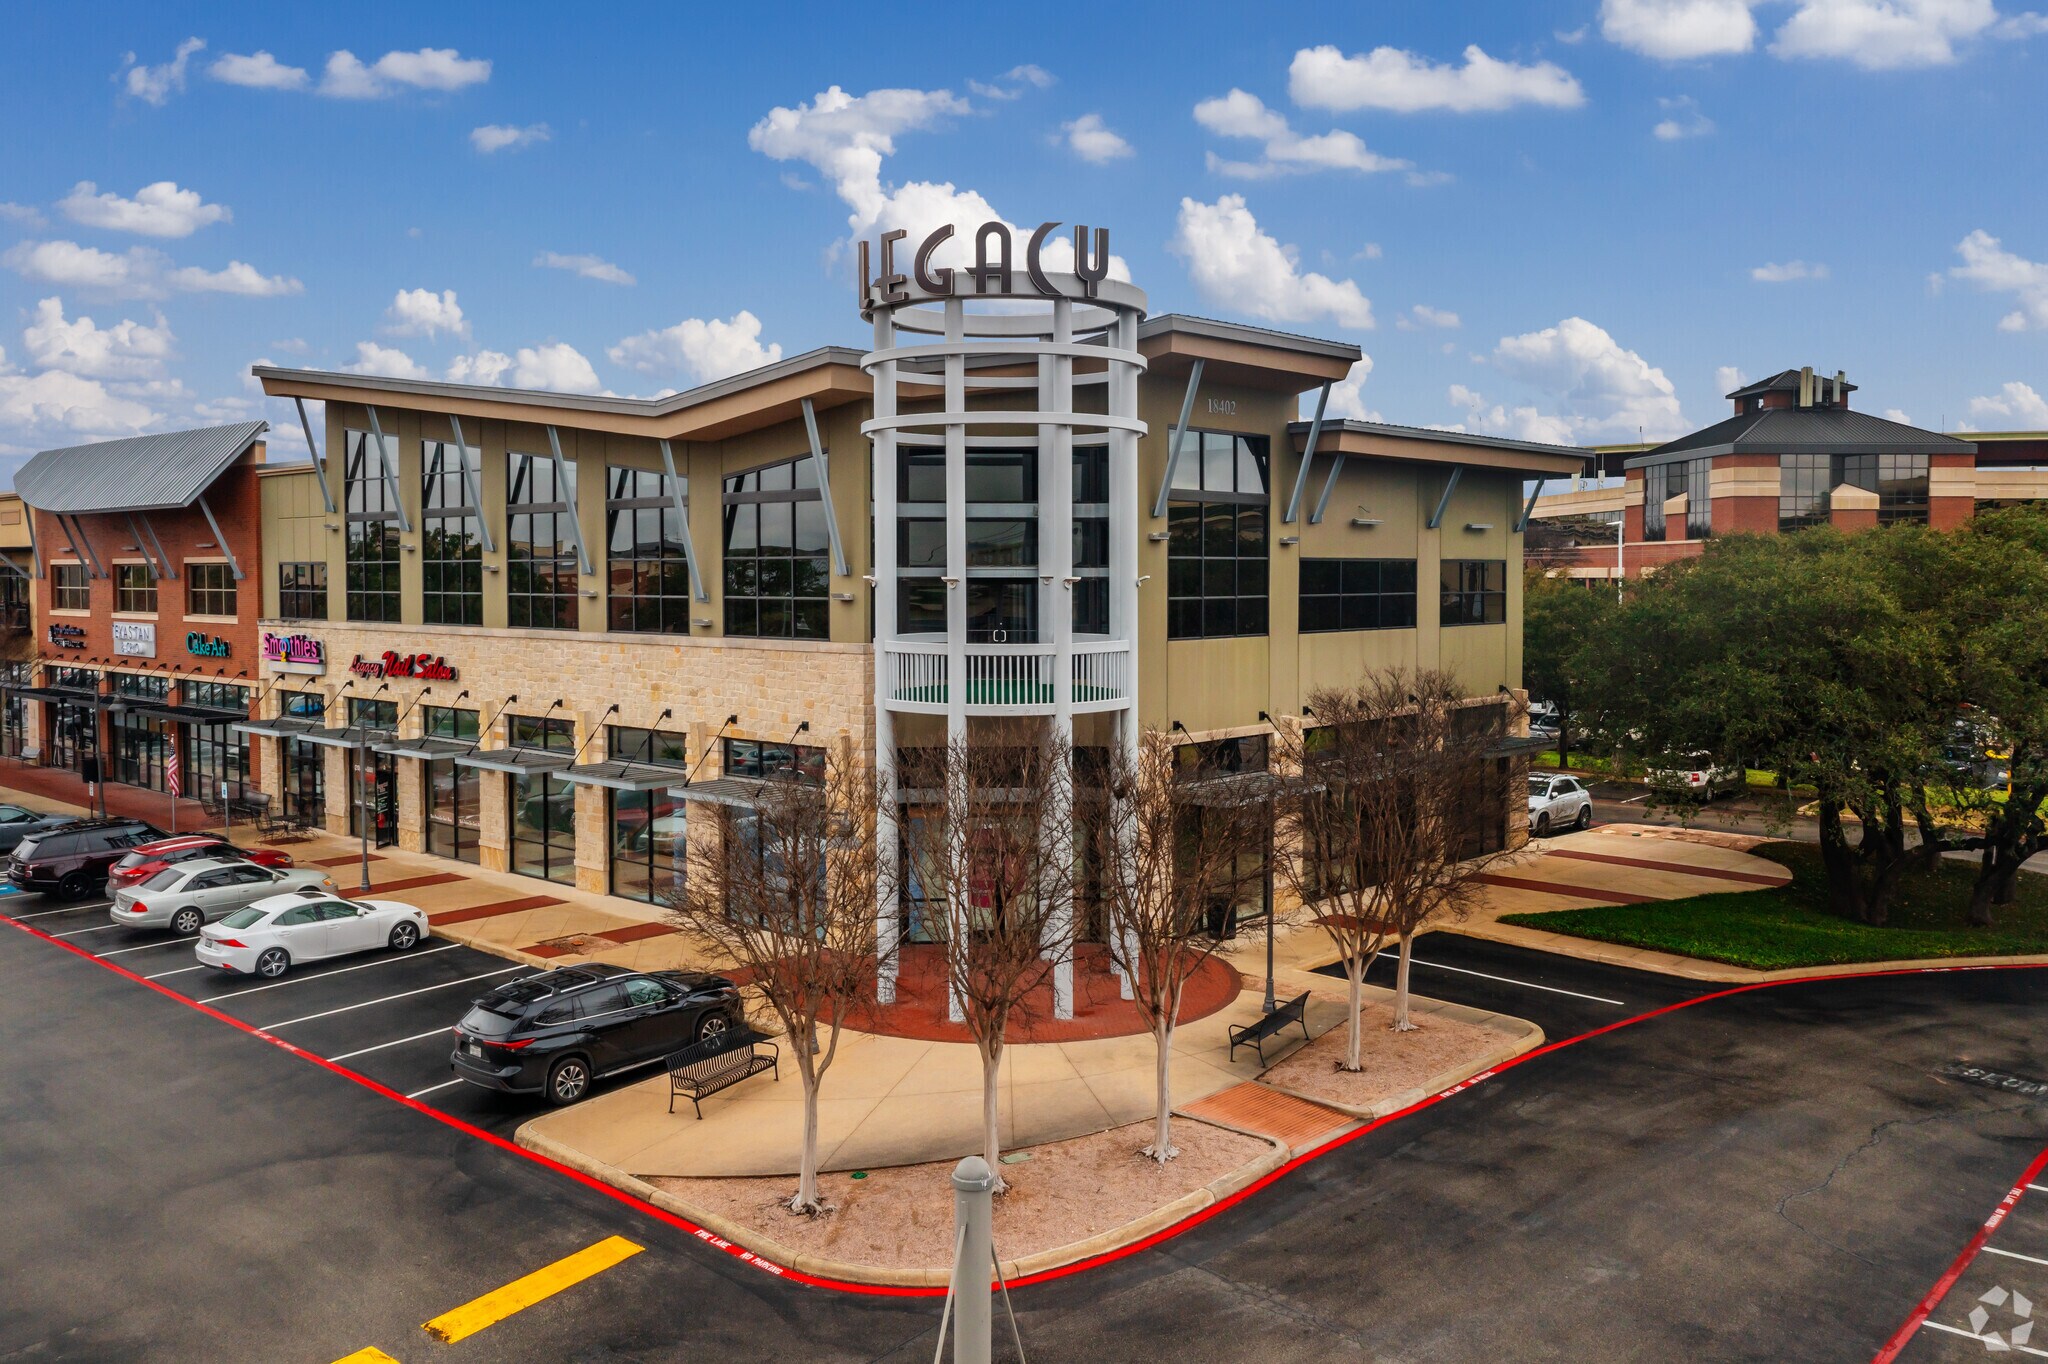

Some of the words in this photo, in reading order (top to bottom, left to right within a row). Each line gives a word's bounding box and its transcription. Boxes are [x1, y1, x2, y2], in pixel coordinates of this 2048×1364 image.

[858, 221, 1109, 309] LEGACY
[1208, 398, 1236, 415] 18402
[186, 630, 210, 655] Cake
[211, 636, 226, 657] Art
[263, 633, 318, 657] Smoothies
[280, 651, 287, 662] 2
[349, 655, 380, 678] Legacy
[382, 651, 413, 677] Nail
[415, 654, 452, 679] Salon
[694, 1229, 713, 1240] FIRE
[710, 1237, 732, 1249] LANE
[740, 1251, 754, 1260] NO
[751, 1257, 784, 1275] PARKING
